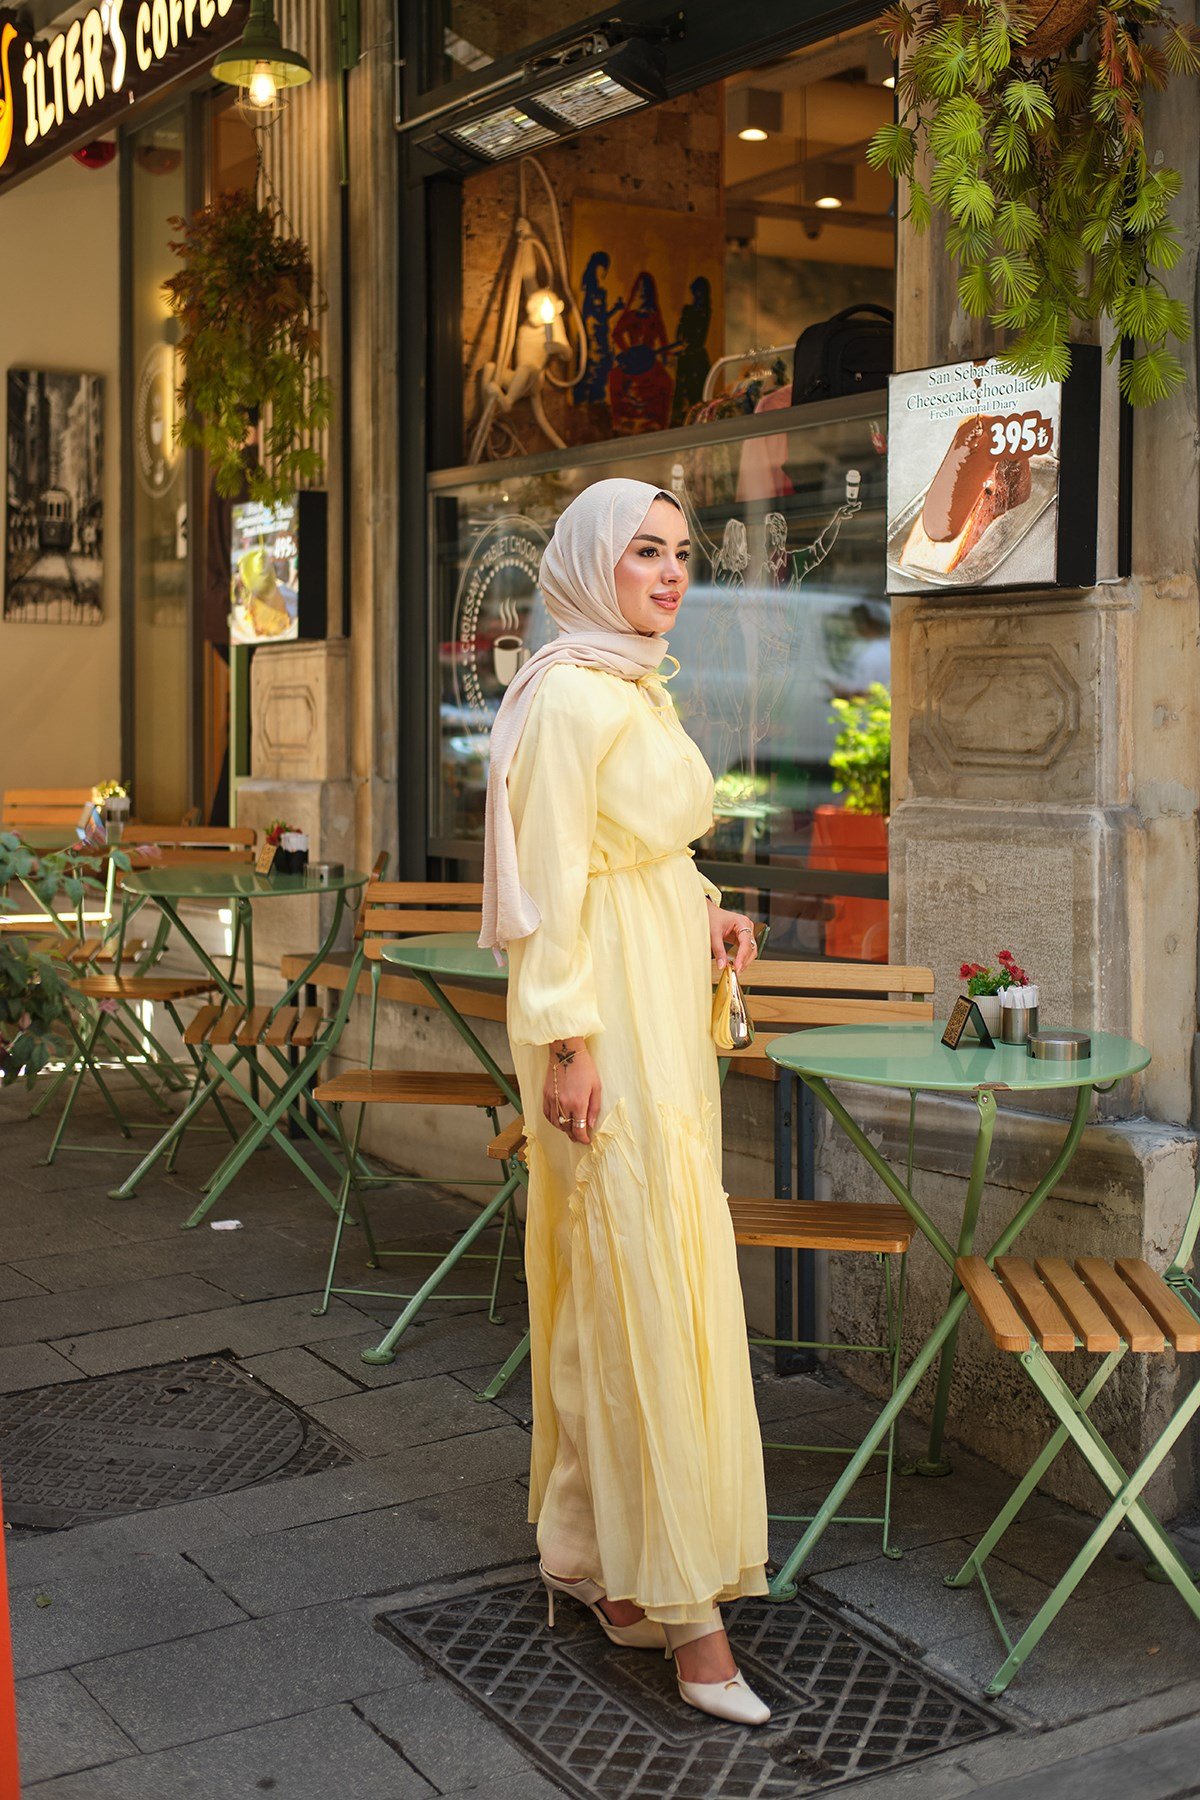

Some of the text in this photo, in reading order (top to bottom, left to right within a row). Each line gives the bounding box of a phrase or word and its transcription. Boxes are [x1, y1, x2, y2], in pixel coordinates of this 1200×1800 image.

[906, 378, 1037, 410] Cheesecakechocolate
[928, 371, 950, 387] San
[929, 399, 1019, 420] Fresh Natural Diary
[990, 418, 1049, 456] 395₺
[461, 569, 482, 653] CROISSANT
